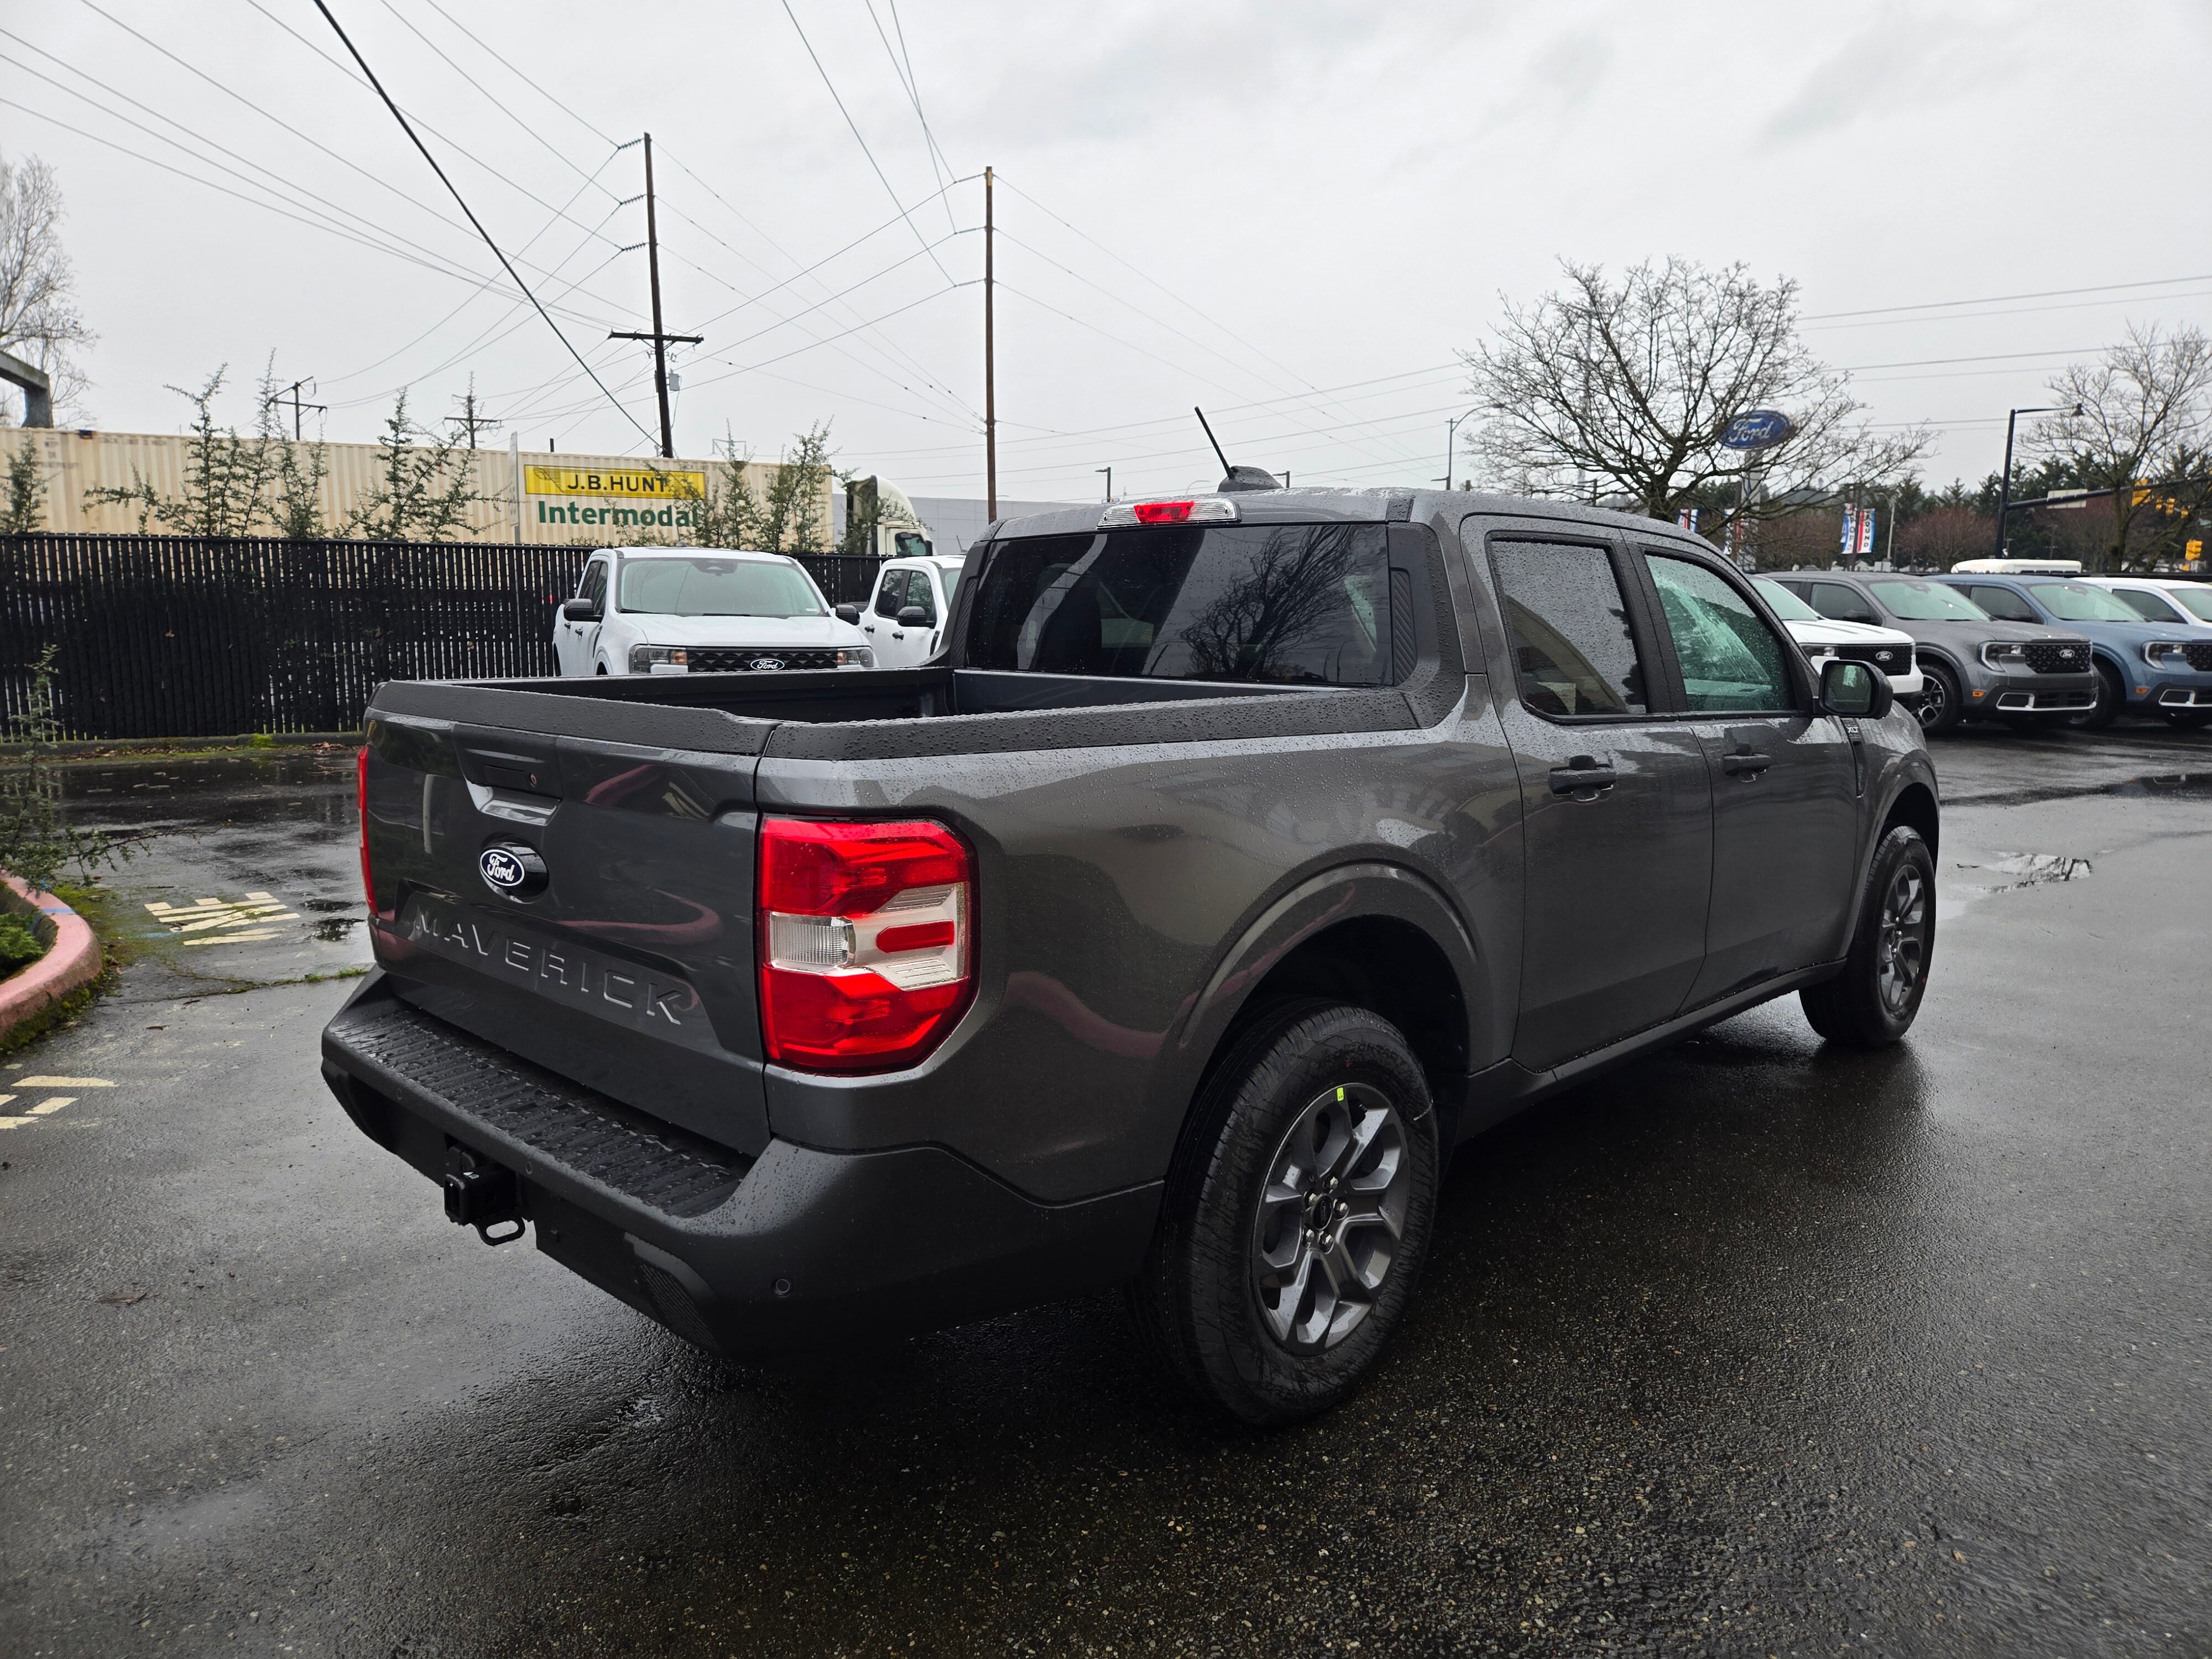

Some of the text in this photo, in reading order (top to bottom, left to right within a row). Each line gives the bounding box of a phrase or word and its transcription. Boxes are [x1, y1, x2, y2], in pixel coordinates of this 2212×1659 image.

[1728, 418, 1774, 442] Ford
[539, 500, 698, 527] Intermodal
[757, 660, 779, 669] Ford
[487, 853, 515, 881] Ford
[416, 905, 682, 1025] MAVERICK
